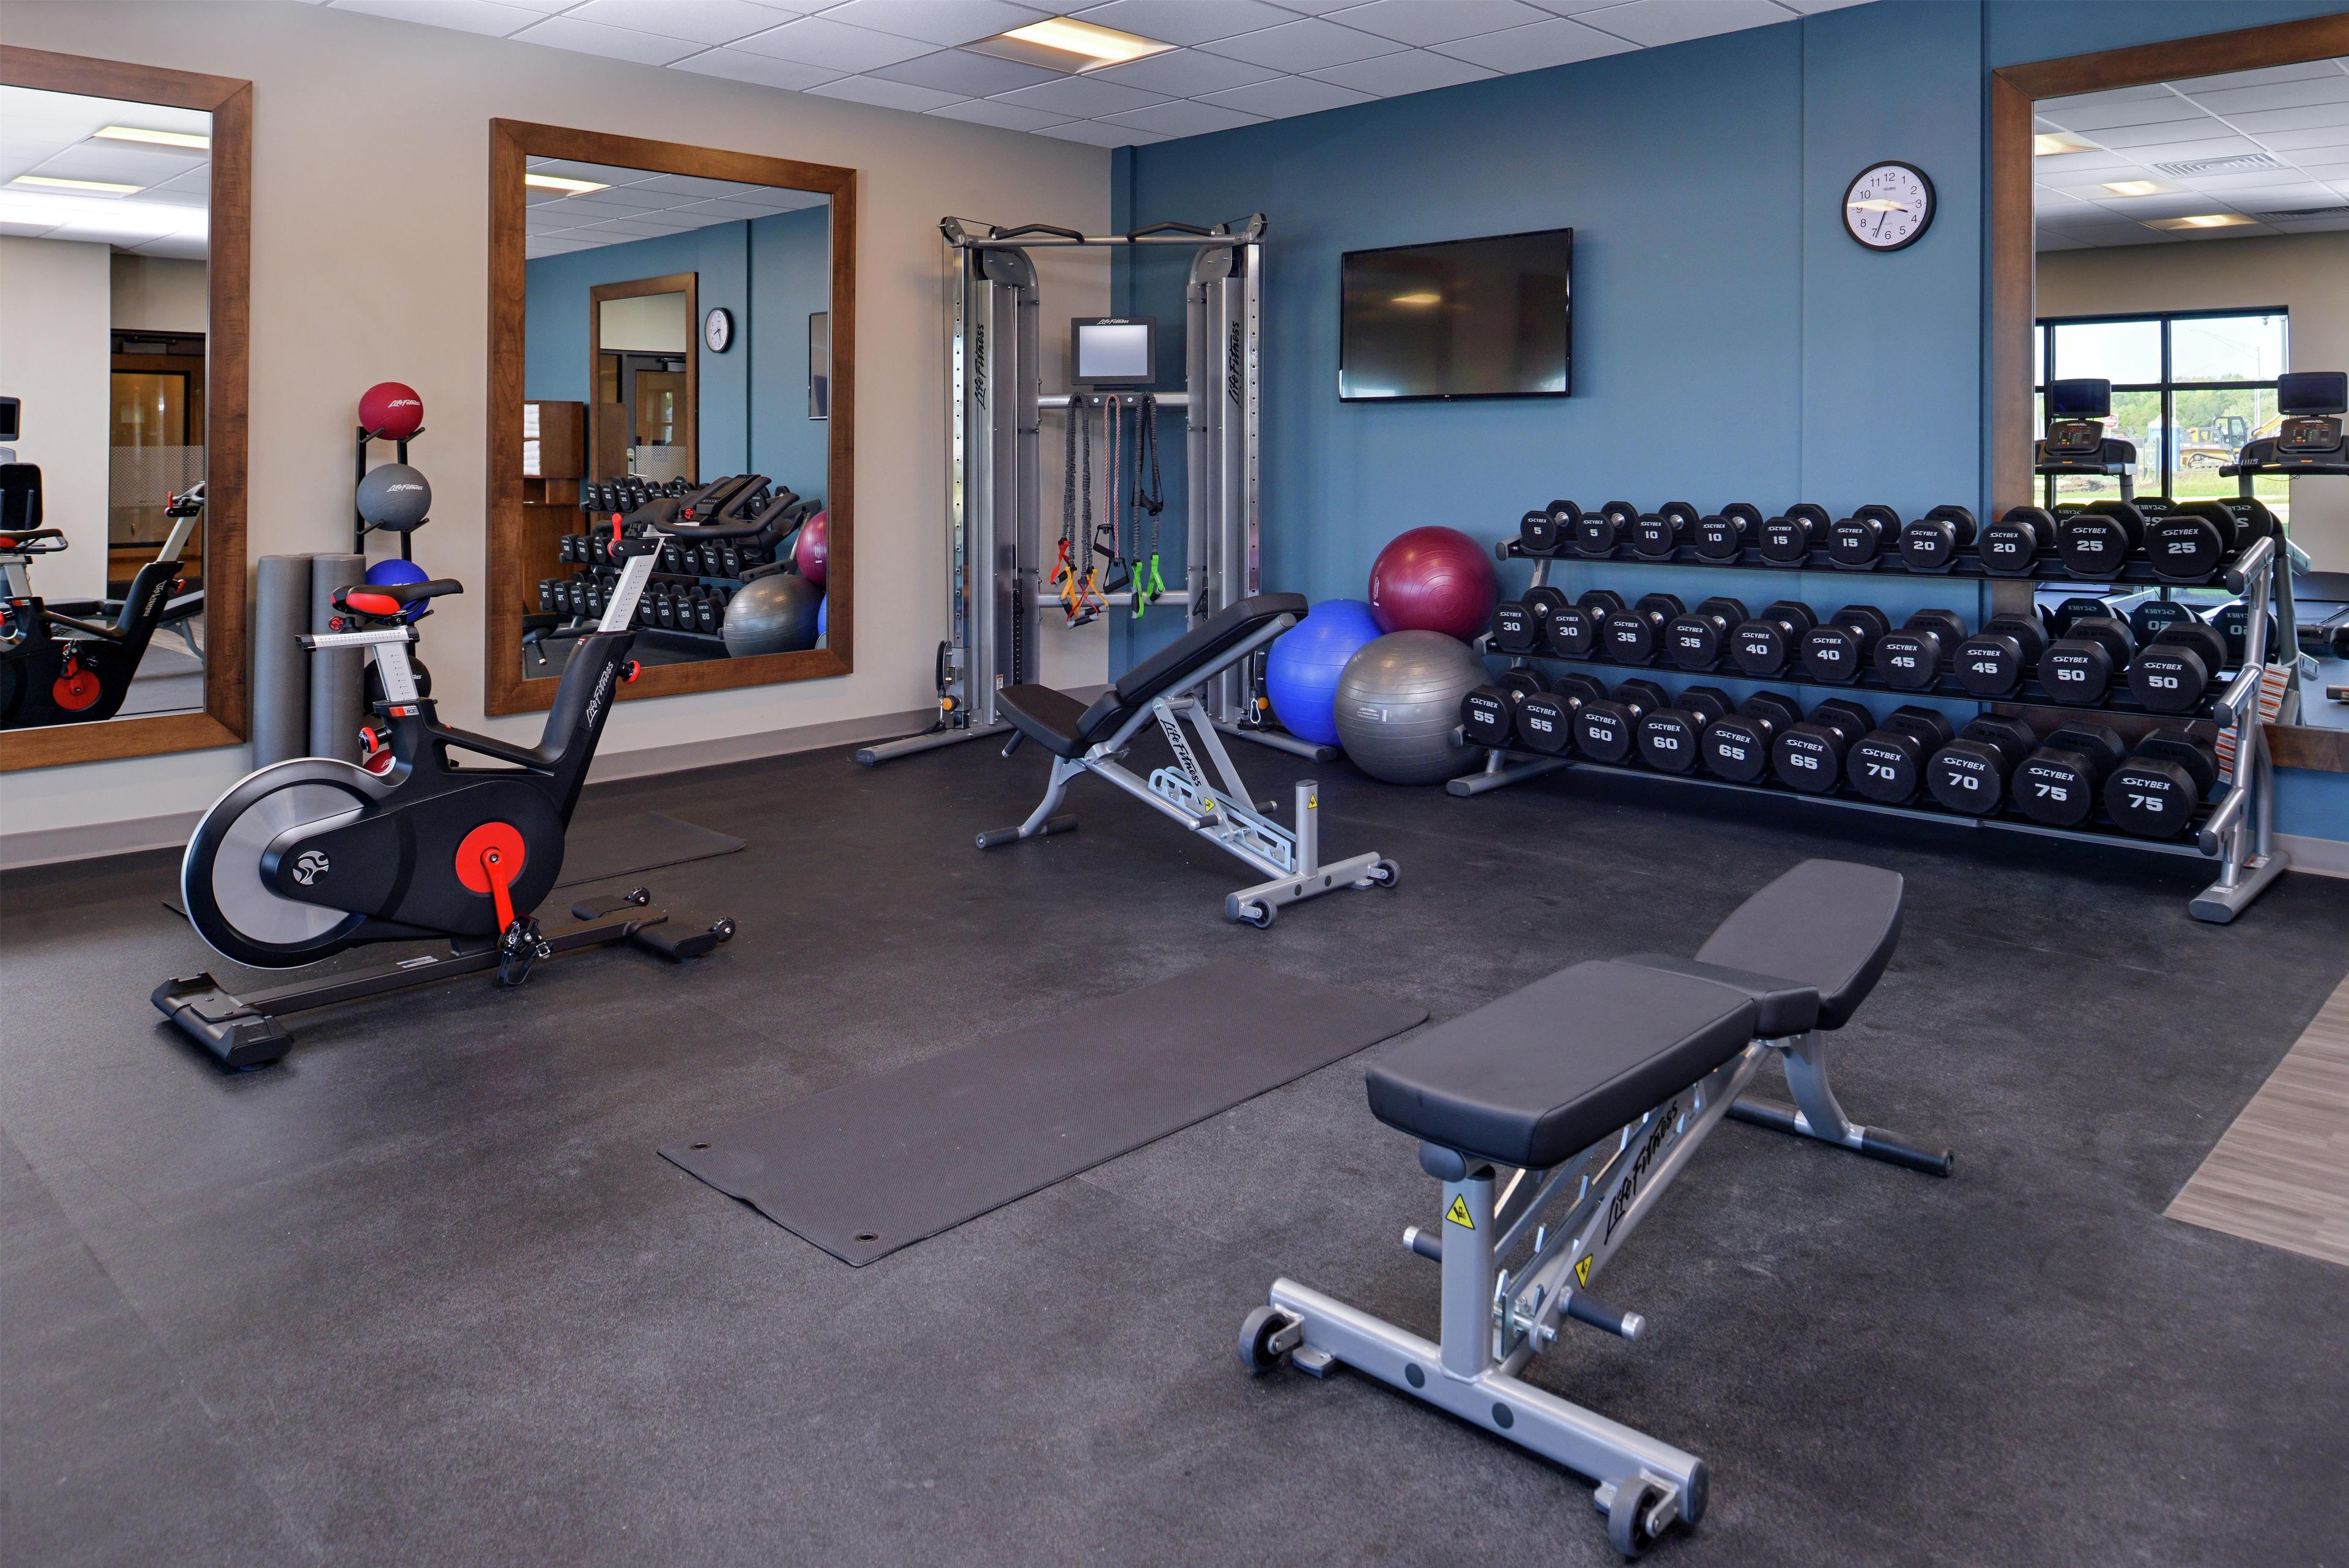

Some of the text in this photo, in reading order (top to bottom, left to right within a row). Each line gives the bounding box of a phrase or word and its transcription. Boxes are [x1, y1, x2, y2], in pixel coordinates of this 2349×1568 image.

[1870, 178, 1880, 187] 11
[1884, 173, 1895, 182] 12
[1901, 176, 1906, 184] 1
[1860, 190, 1871, 199] 10
[1910, 186, 1917, 195] 2
[1915, 199, 1922, 209] 3
[1860, 218, 1866, 228] 8
[1911, 215, 1918, 223] 4
[1871, 228, 1877, 237] 7
[1885, 231, 1891, 239] 6
[1899, 226, 1906, 235] 5
[974, 323, 987, 411] Life Fitness
[1228, 321, 1241, 409] Life Fitness
[387, 484, 401, 492] Life
[1645, 530, 1658, 539] 10
[1708, 533, 1722, 541] 10
[1773, 536, 1788, 544] 15
[1842, 538, 1858, 547] 15
[1913, 540, 1935, 551] 20
[1994, 543, 2016, 553] 20
[2077, 540, 2103, 551] 25
[2168, 542, 2196, 554] 25
[1503, 622, 1521, 631] 30
[1559, 626, 1578, 636] 30
[1617, 632, 1636, 642] 35
[1680, 637, 1701, 648] 35
[1746, 644, 1767, 655] 40
[1817, 650, 1840, 660] 40
[1891, 656, 1915, 667] 45
[1972, 662, 1998, 674] 45
[2057, 669, 2085, 682] 50
[2148, 675, 2178, 689] 50
[586, 661, 614, 728] Life Fitness
[1479, 699, 1498, 708] CYBEX
[1535, 706, 1556, 716] CYBEX
[1474, 710, 1494, 724] 55
[1594, 715, 1617, 725] CYBEX
[1531, 718, 1553, 732] 55
[1589, 727, 1612, 741] 60
[1725, 731, 1751, 743] CYBEX
[1653, 737, 1678, 750] 60
[1797, 740, 1824, 752] CYBEX
[1160, 719, 1202, 787] Life Fitness
[1719, 744, 1745, 760] 65
[1872, 749, 1901, 761] CYBEX
[1791, 754, 1817, 770] 65
[1955, 759, 1986, 771] CYBEX
[1866, 762, 1895, 780] 70
[2042, 768, 2075, 781] CYBEX
[1948, 772, 1978, 790] 70
[2136, 778, 2170, 790] CYBEX
[2035, 783, 2067, 801] 75
[2128, 793, 2163, 812] 75
[1604, 1100, 1679, 1246] Life Fitness
